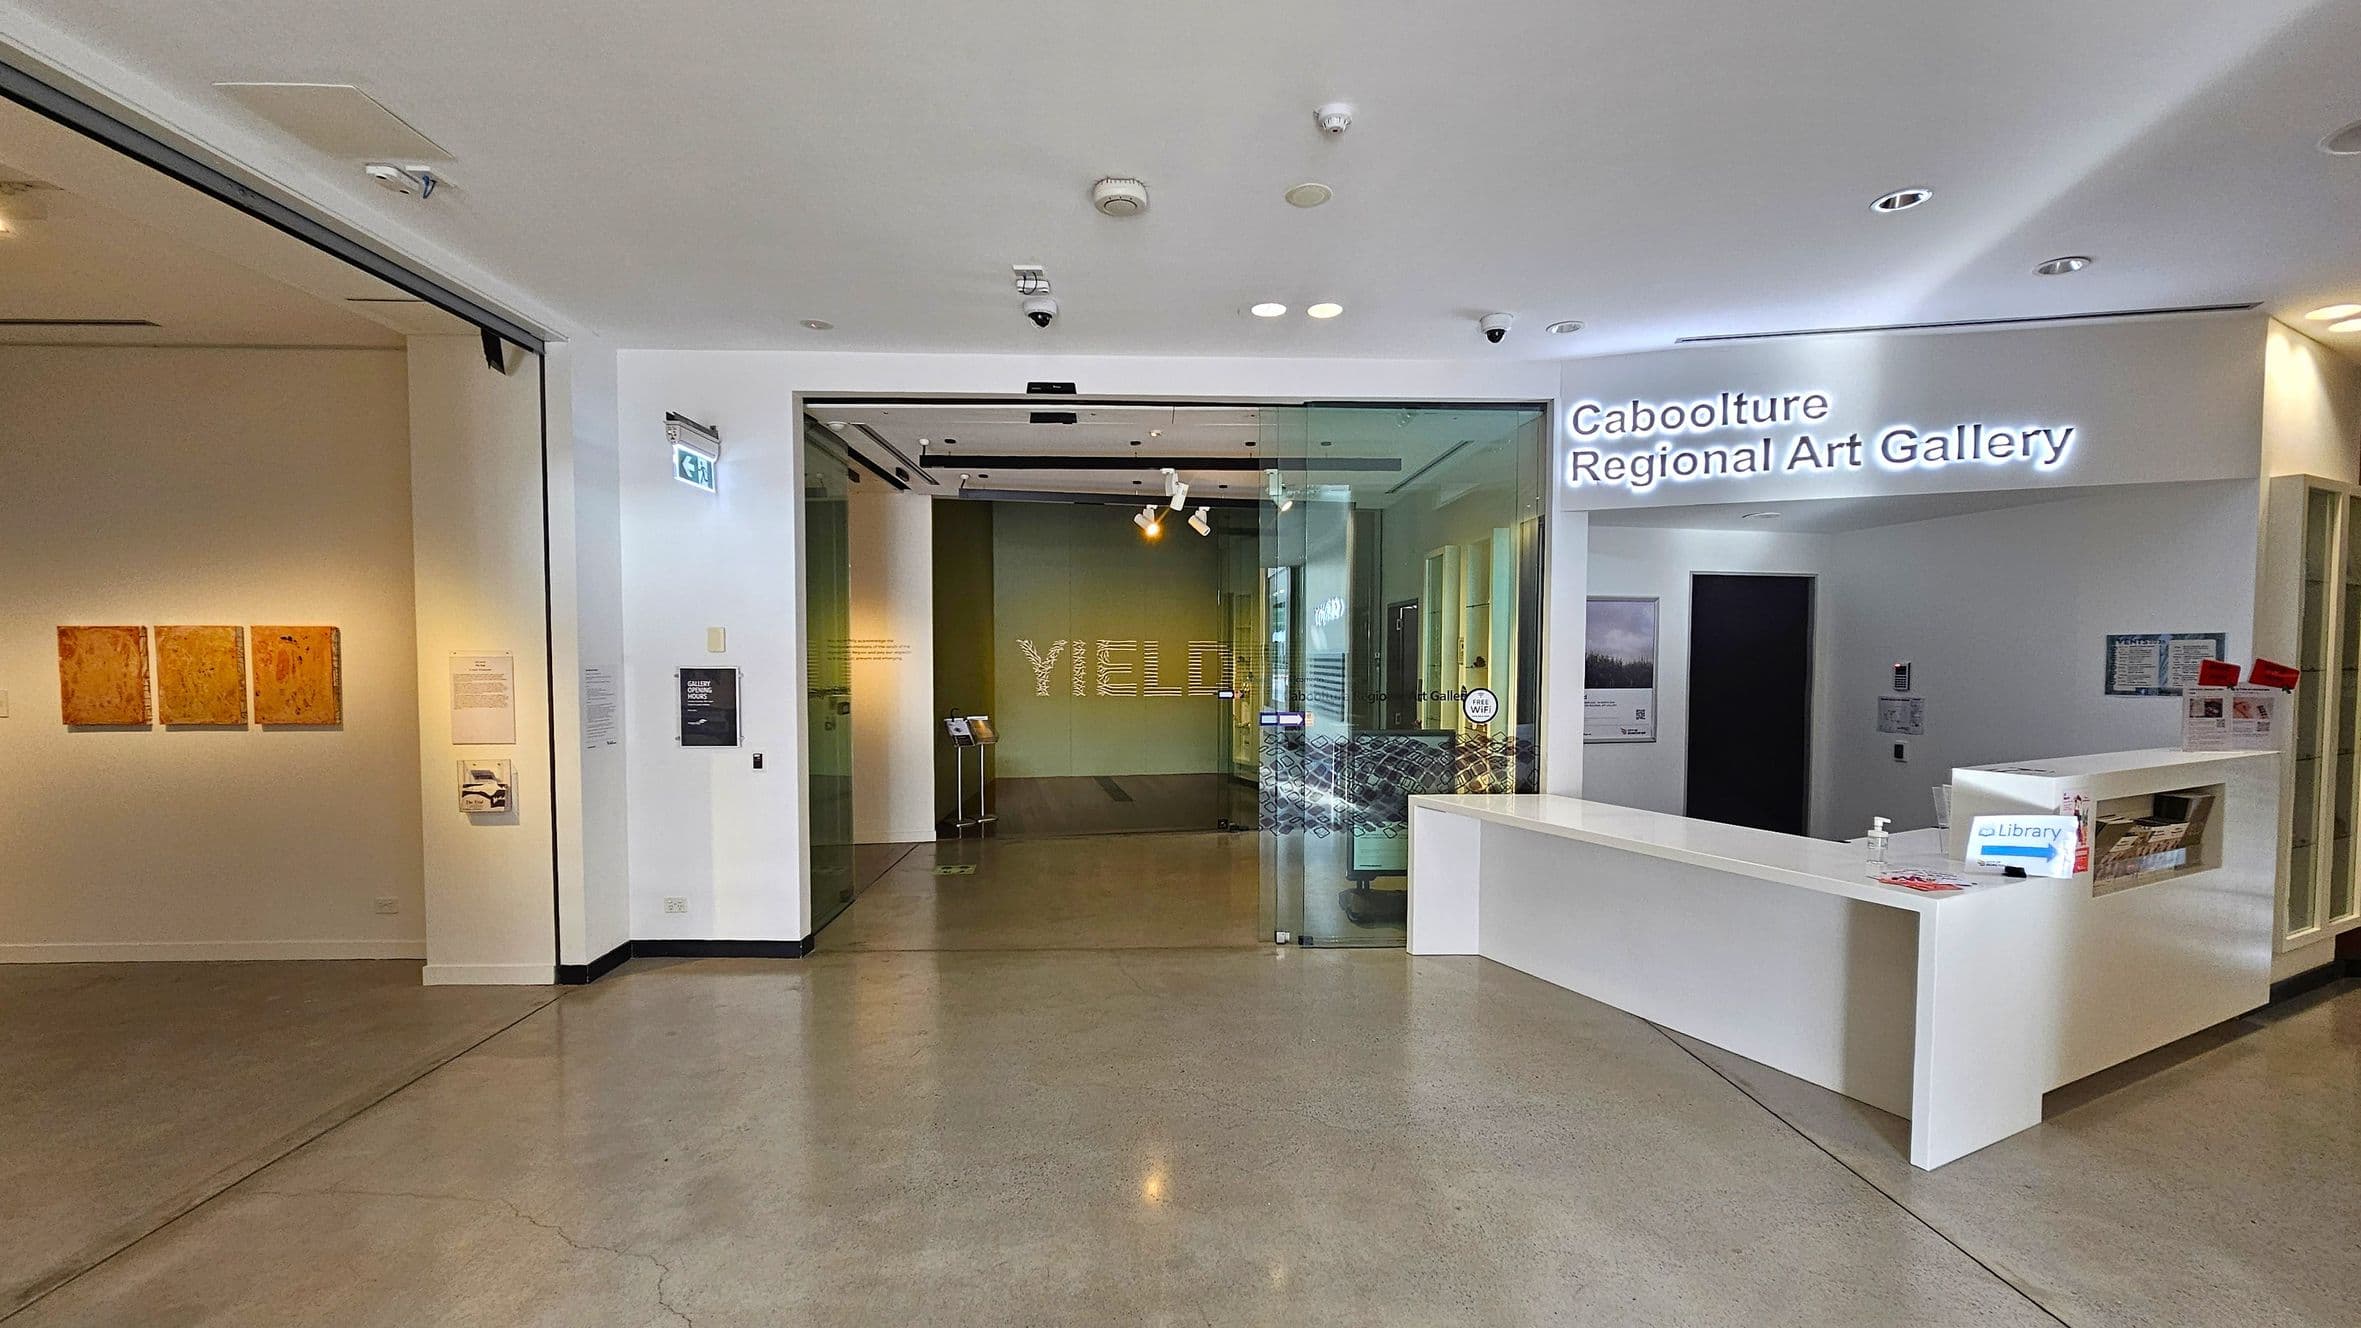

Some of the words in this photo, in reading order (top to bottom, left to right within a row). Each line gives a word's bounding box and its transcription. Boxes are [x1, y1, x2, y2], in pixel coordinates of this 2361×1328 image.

[1572, 391, 1829, 435] Caboolture
[1572, 438, 1771, 487] Regional
[1787, 433, 1863, 470] Art
[1881, 423, 2075, 465] Gallery
[1016, 639, 1235, 697] YIELD
[1470, 705, 1492, 714] WiFi
[1998, 823, 2062, 842] Library
